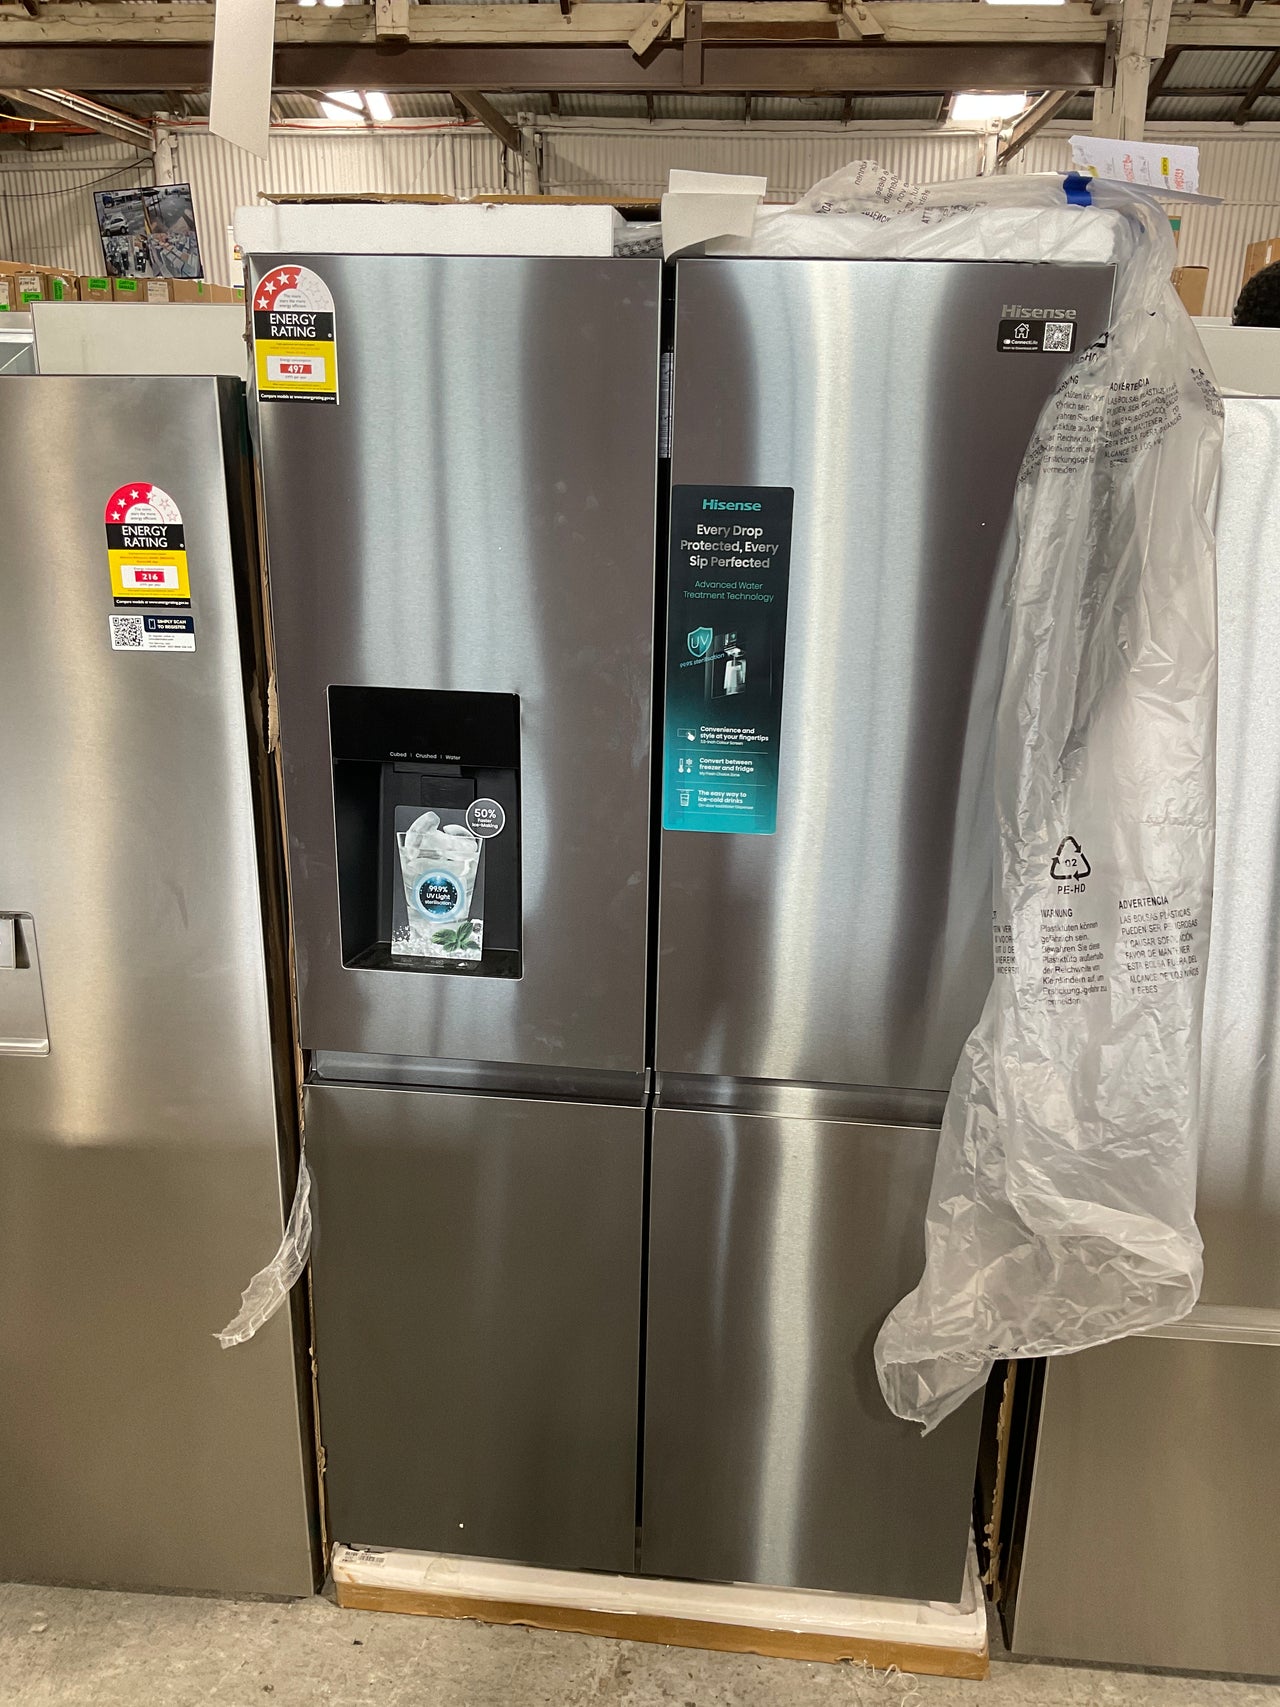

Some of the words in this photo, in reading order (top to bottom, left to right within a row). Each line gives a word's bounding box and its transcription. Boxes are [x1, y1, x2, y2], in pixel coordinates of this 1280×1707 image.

[1001, 304, 1077, 320] Hisense
[270, 314, 316, 325] ENERGY
[271, 326, 316, 338] RATING
[288, 365, 304, 374] 497
[702, 499, 762, 511] Hisense
[122, 526, 167, 536] ENERGY
[696, 524, 730, 538] Every
[732, 526, 763, 538] Drop
[124, 537, 168, 548] RATING
[680, 540, 742, 553] Protected,
[744, 542, 779, 555] Every
[689, 555, 708, 569] Sip
[710, 556, 770, 568] Perfected
[738, 582, 763, 590] Water
[684, 591, 724, 599] Treatment
[727, 592, 774, 602] Technology
[690, 634, 709, 648] UV
[739, 734, 769, 742] fingertips
[474, 808, 496, 818] 50%
[1057, 884, 1086, 894] PE-HD
[1118, 896, 1168, 909] ADVERTENCIA
